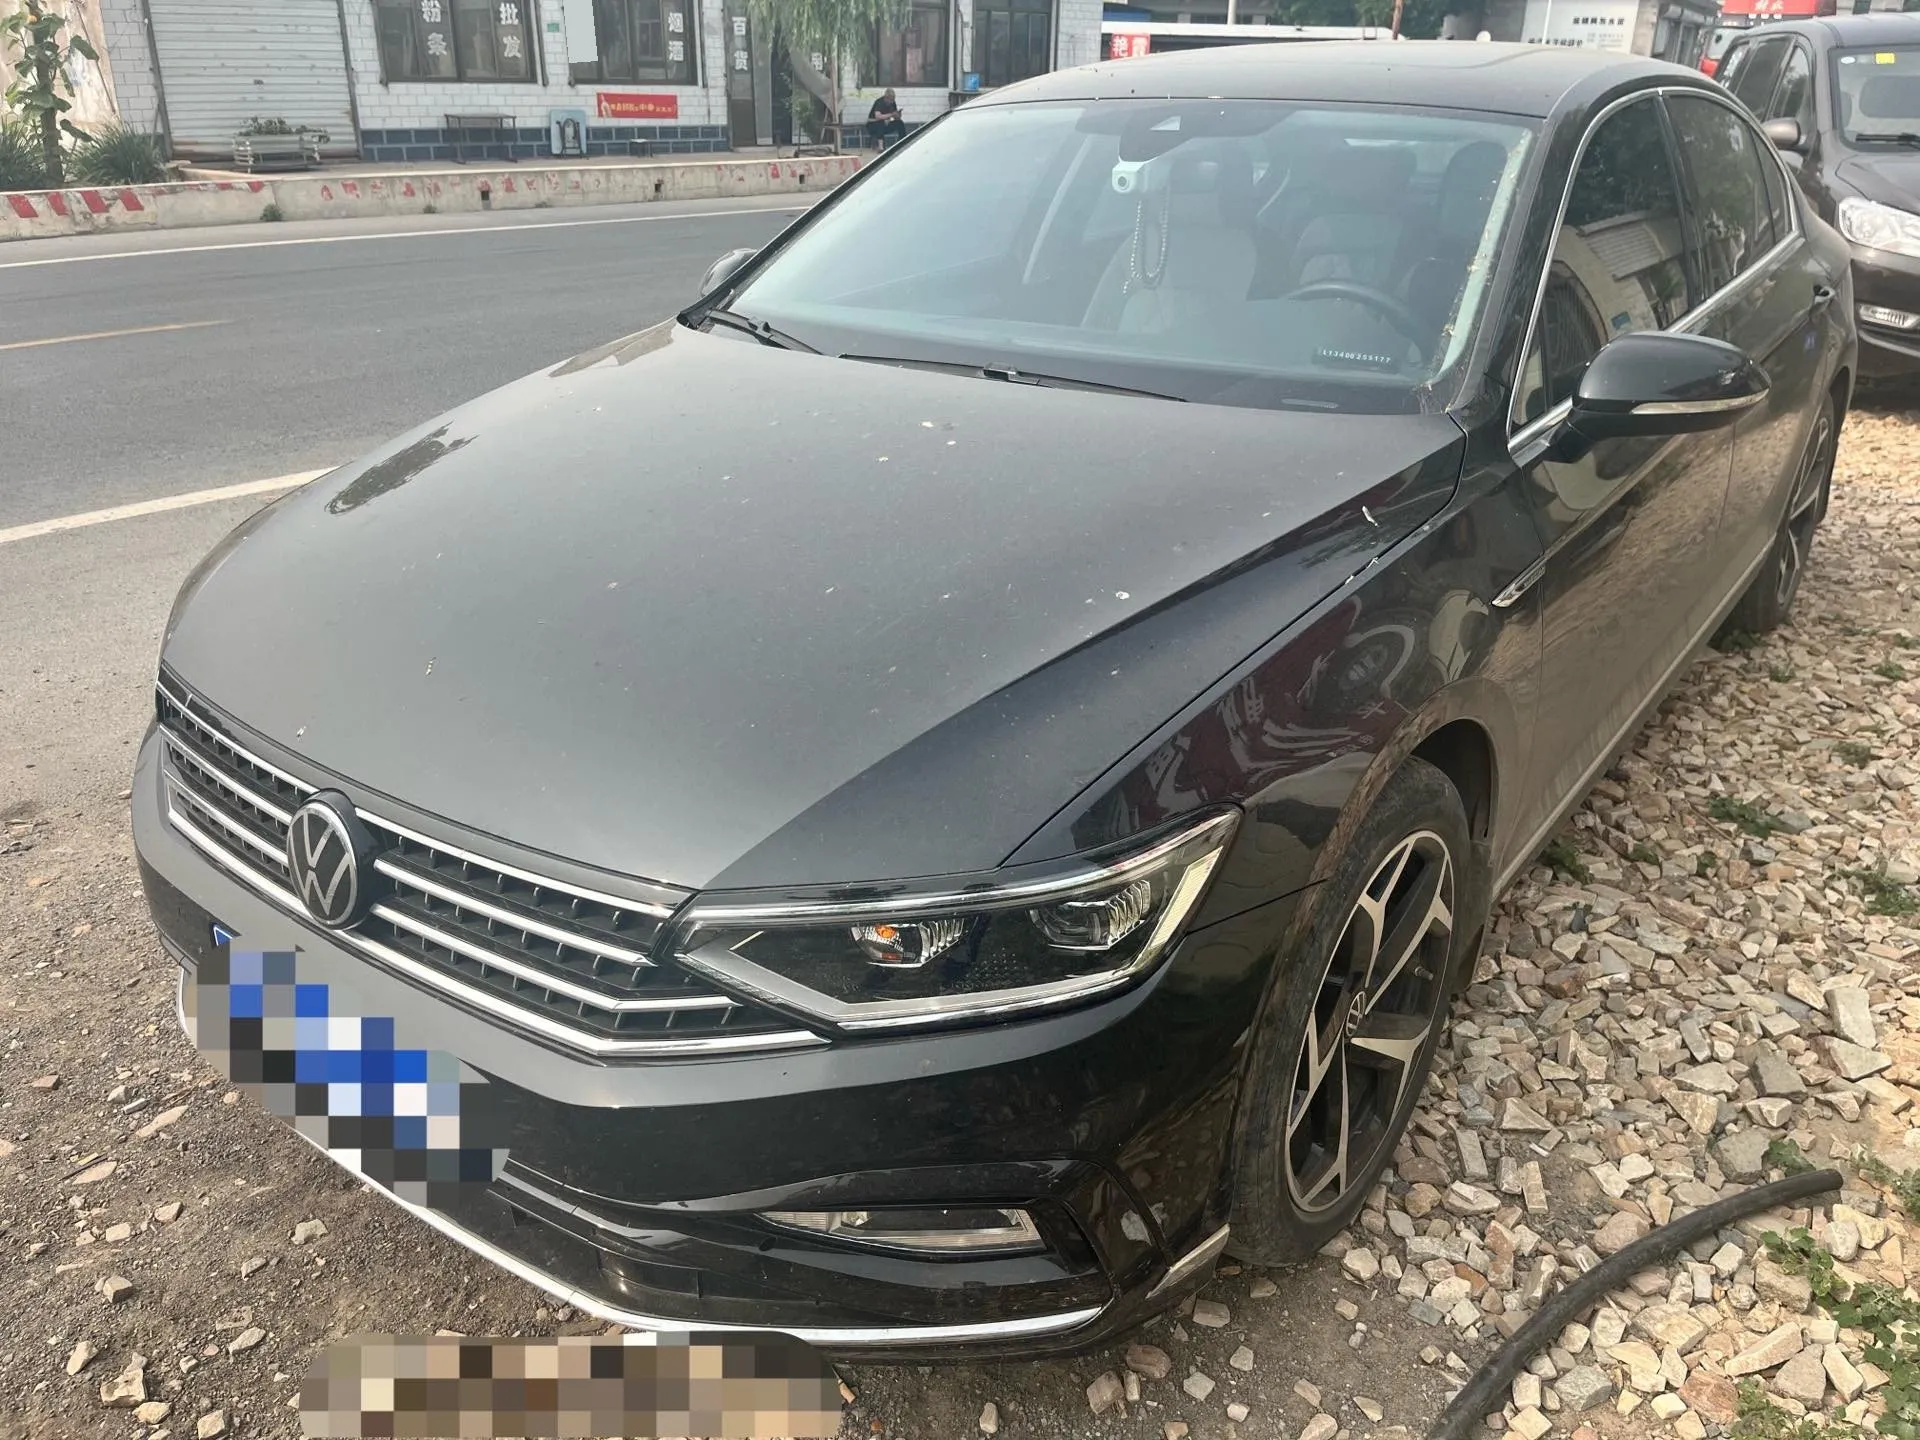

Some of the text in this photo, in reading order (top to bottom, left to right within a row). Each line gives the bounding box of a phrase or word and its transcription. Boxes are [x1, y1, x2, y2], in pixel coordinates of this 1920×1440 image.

[499, 2, 521, 57] 批发
[668, 12, 684, 61] 烟酒
[732, 16, 748, 71] 百货
